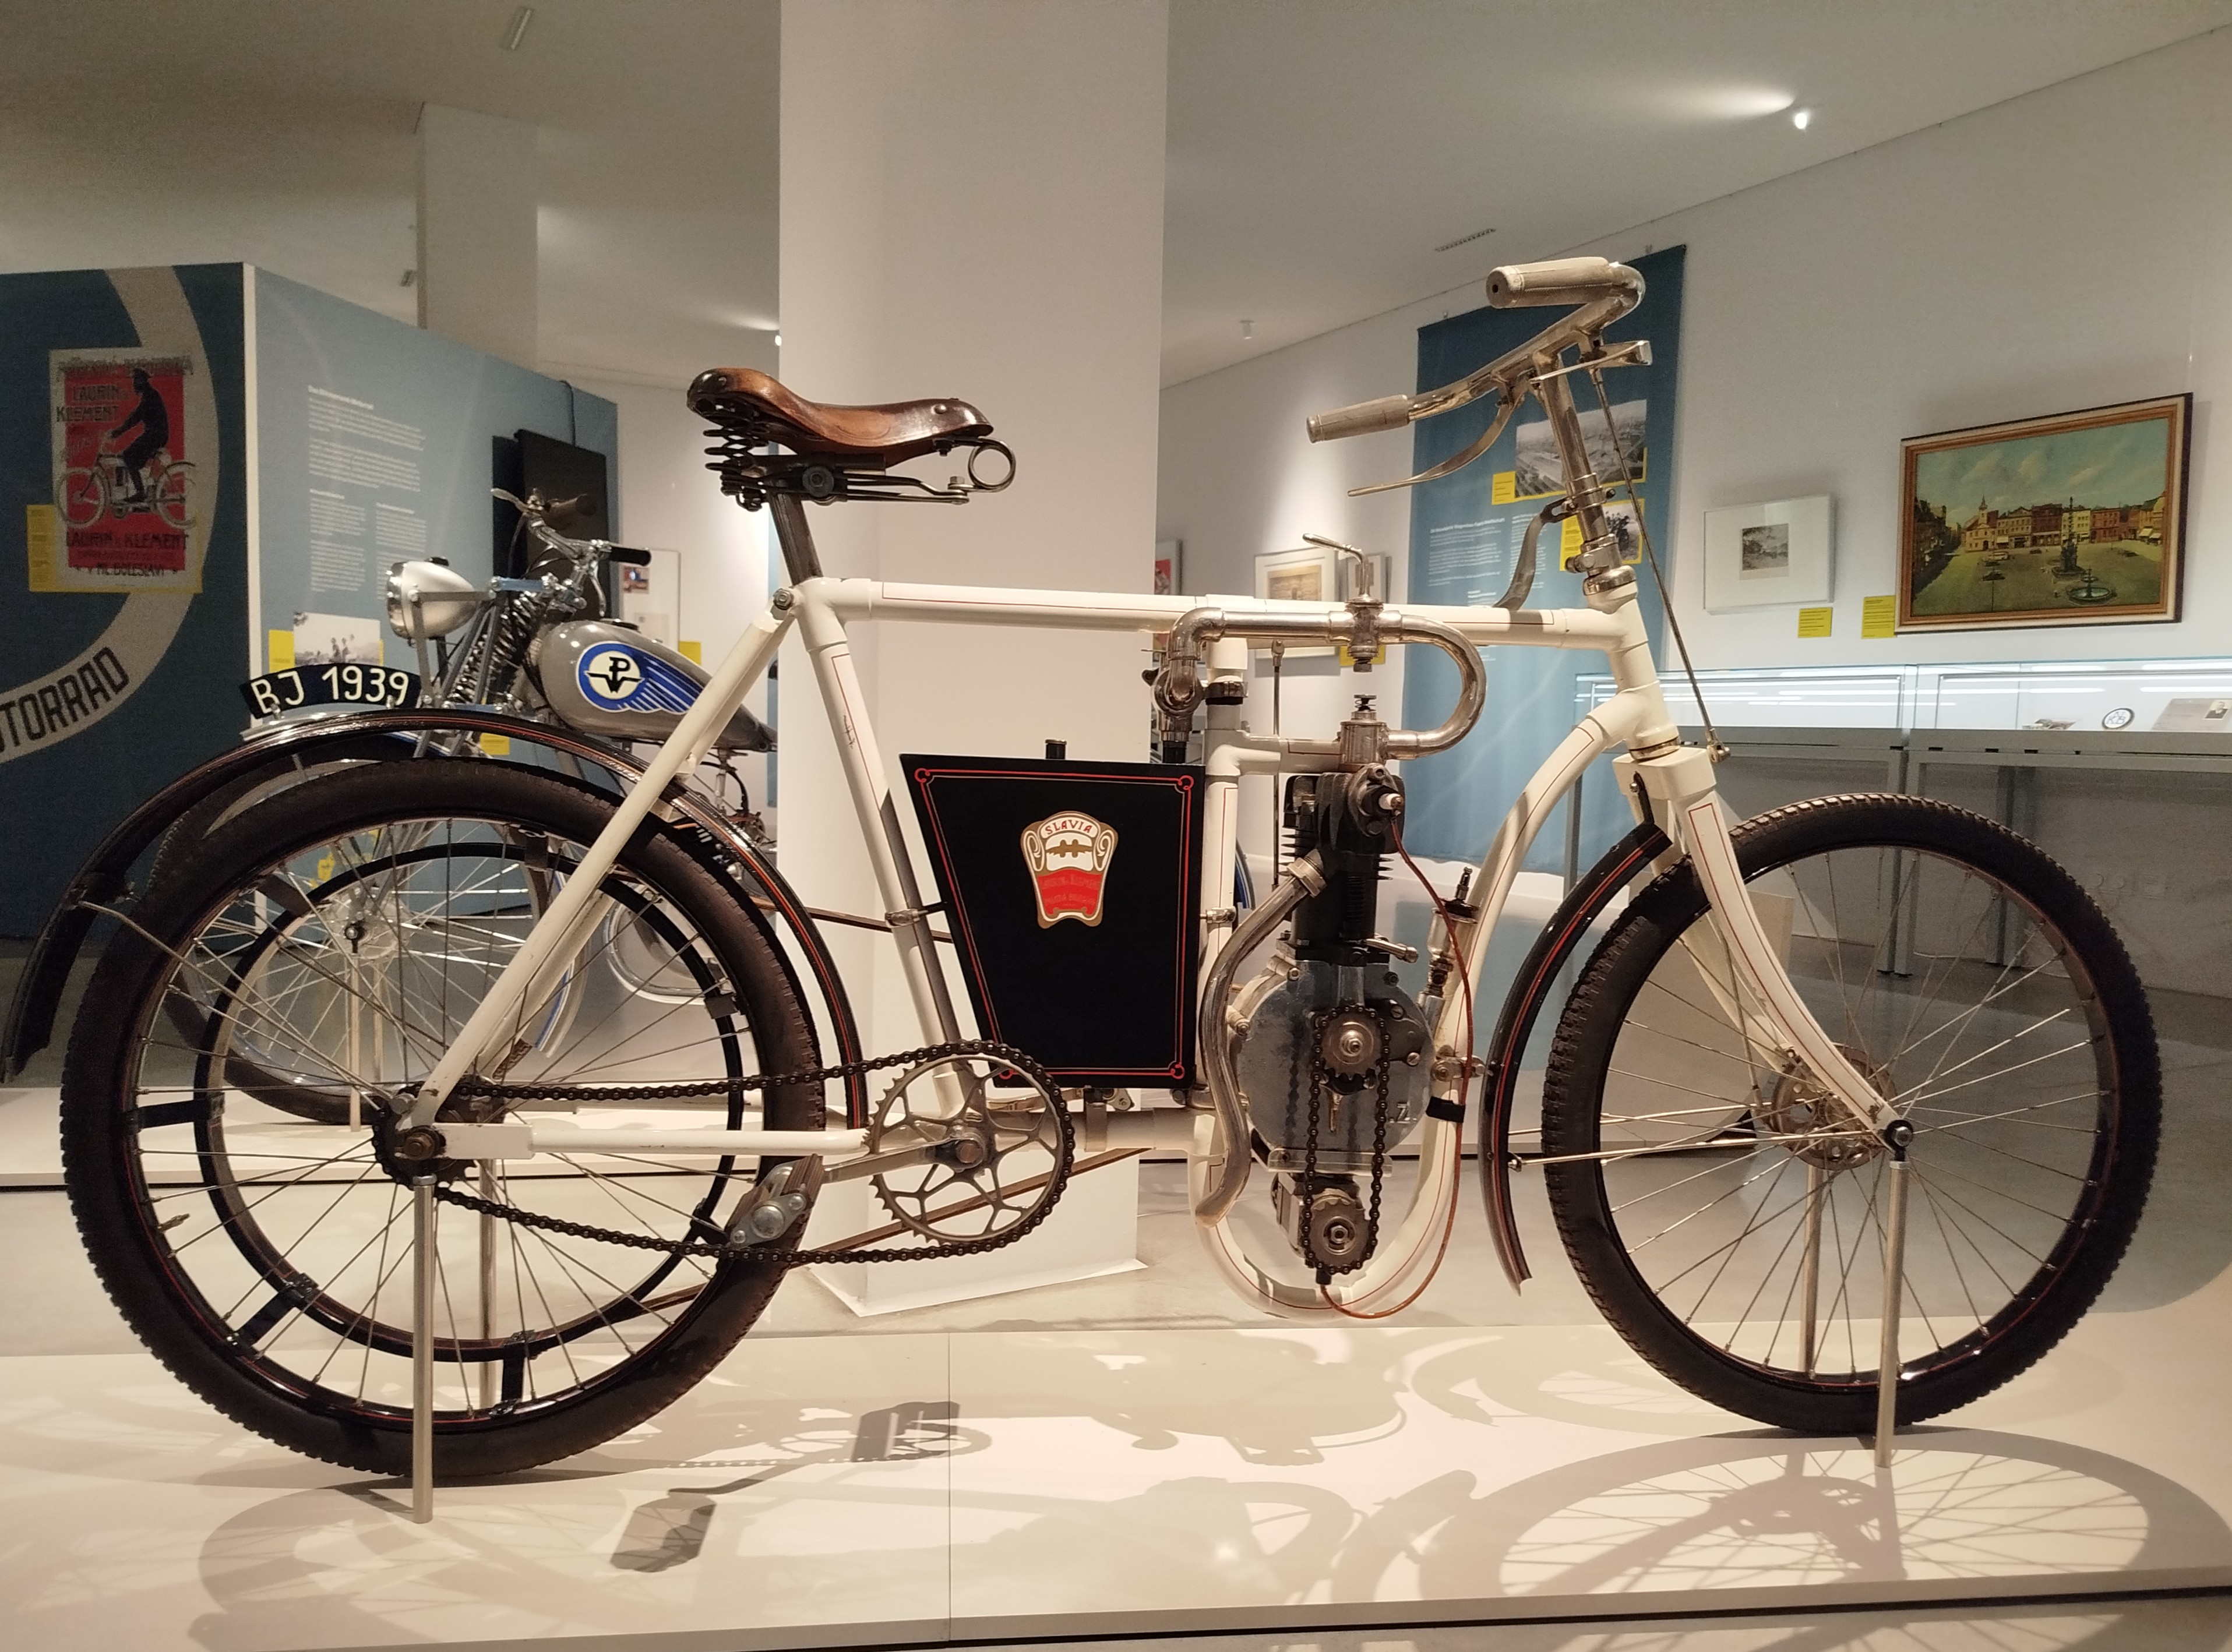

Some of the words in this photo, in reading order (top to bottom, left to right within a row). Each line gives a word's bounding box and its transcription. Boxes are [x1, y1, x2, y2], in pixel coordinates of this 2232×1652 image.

[251, 670, 305, 715] BJ
[322, 666, 409, 706] 1939
[1045, 820, 1093, 835] SLAVIA
